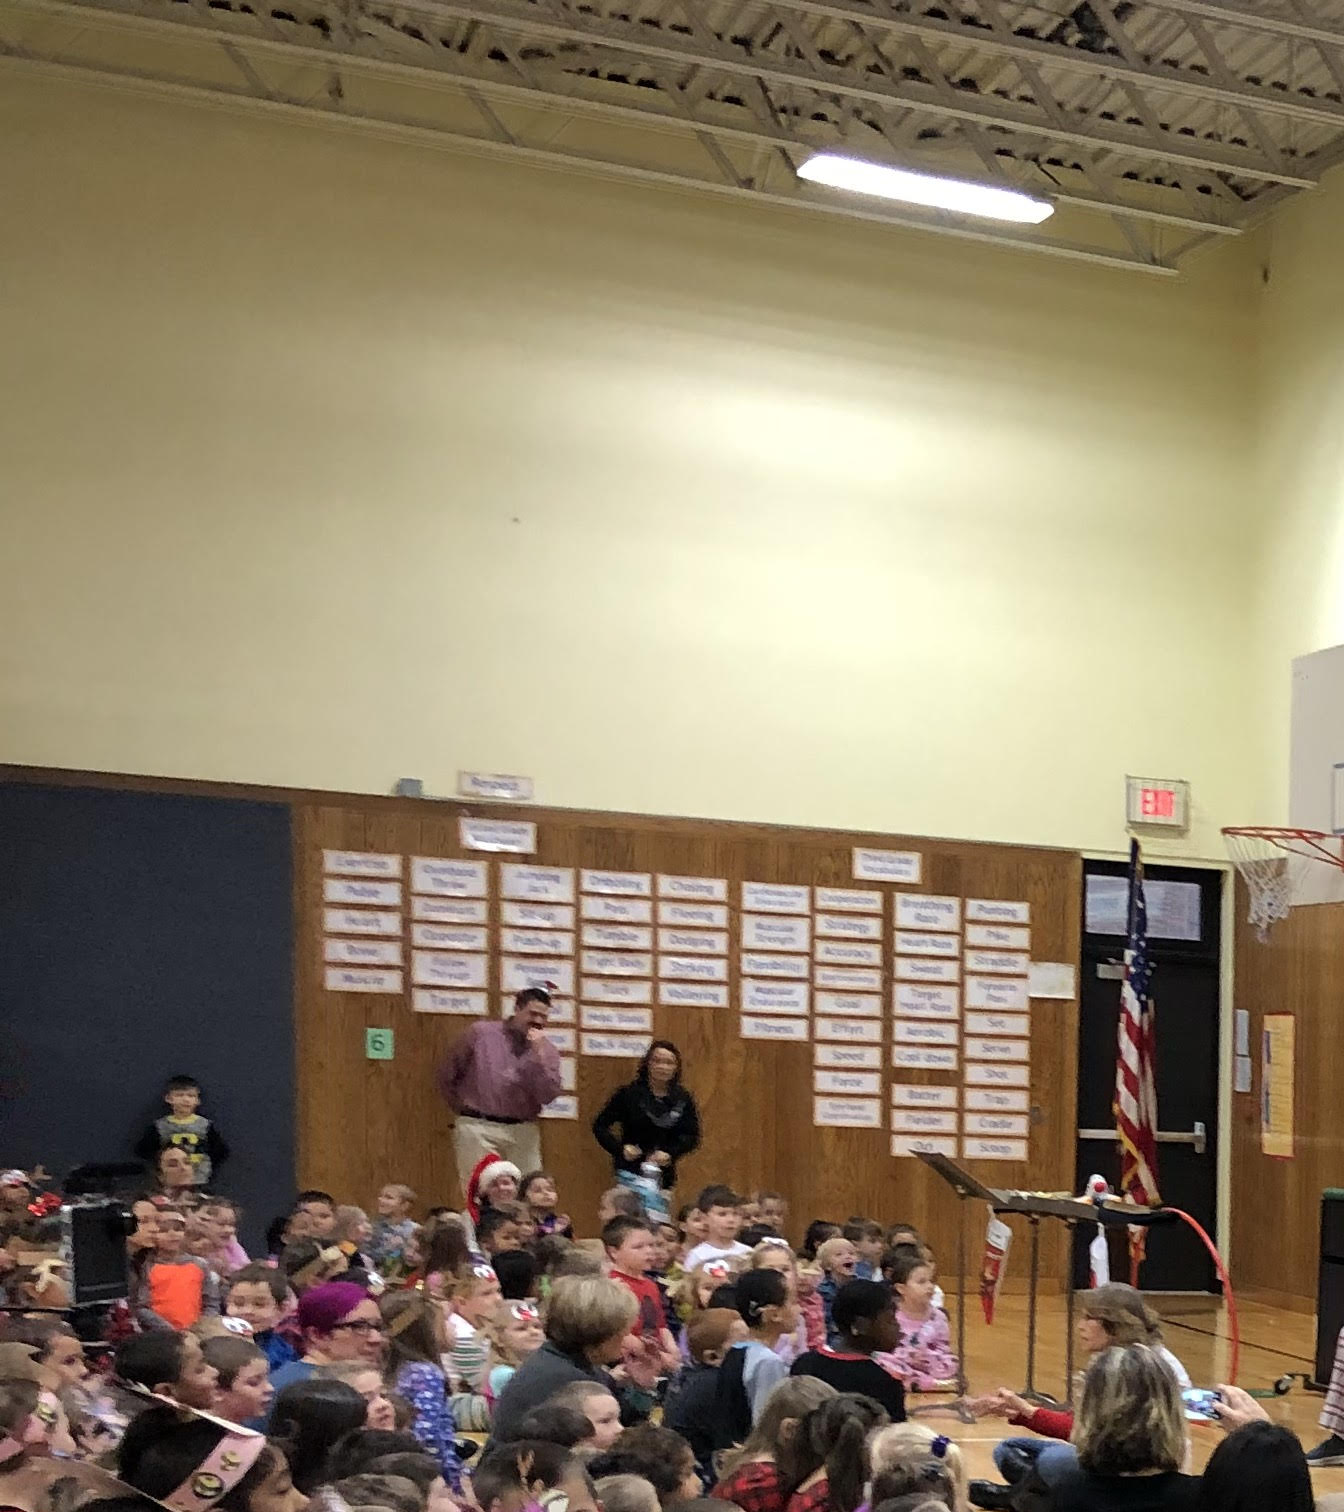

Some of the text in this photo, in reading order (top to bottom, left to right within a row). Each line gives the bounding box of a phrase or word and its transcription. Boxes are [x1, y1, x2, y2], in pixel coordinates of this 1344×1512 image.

[1141, 788, 1175, 817] EXIT
[669, 880, 714, 896] Chasing
[371, 1032, 385, 1051] 6
